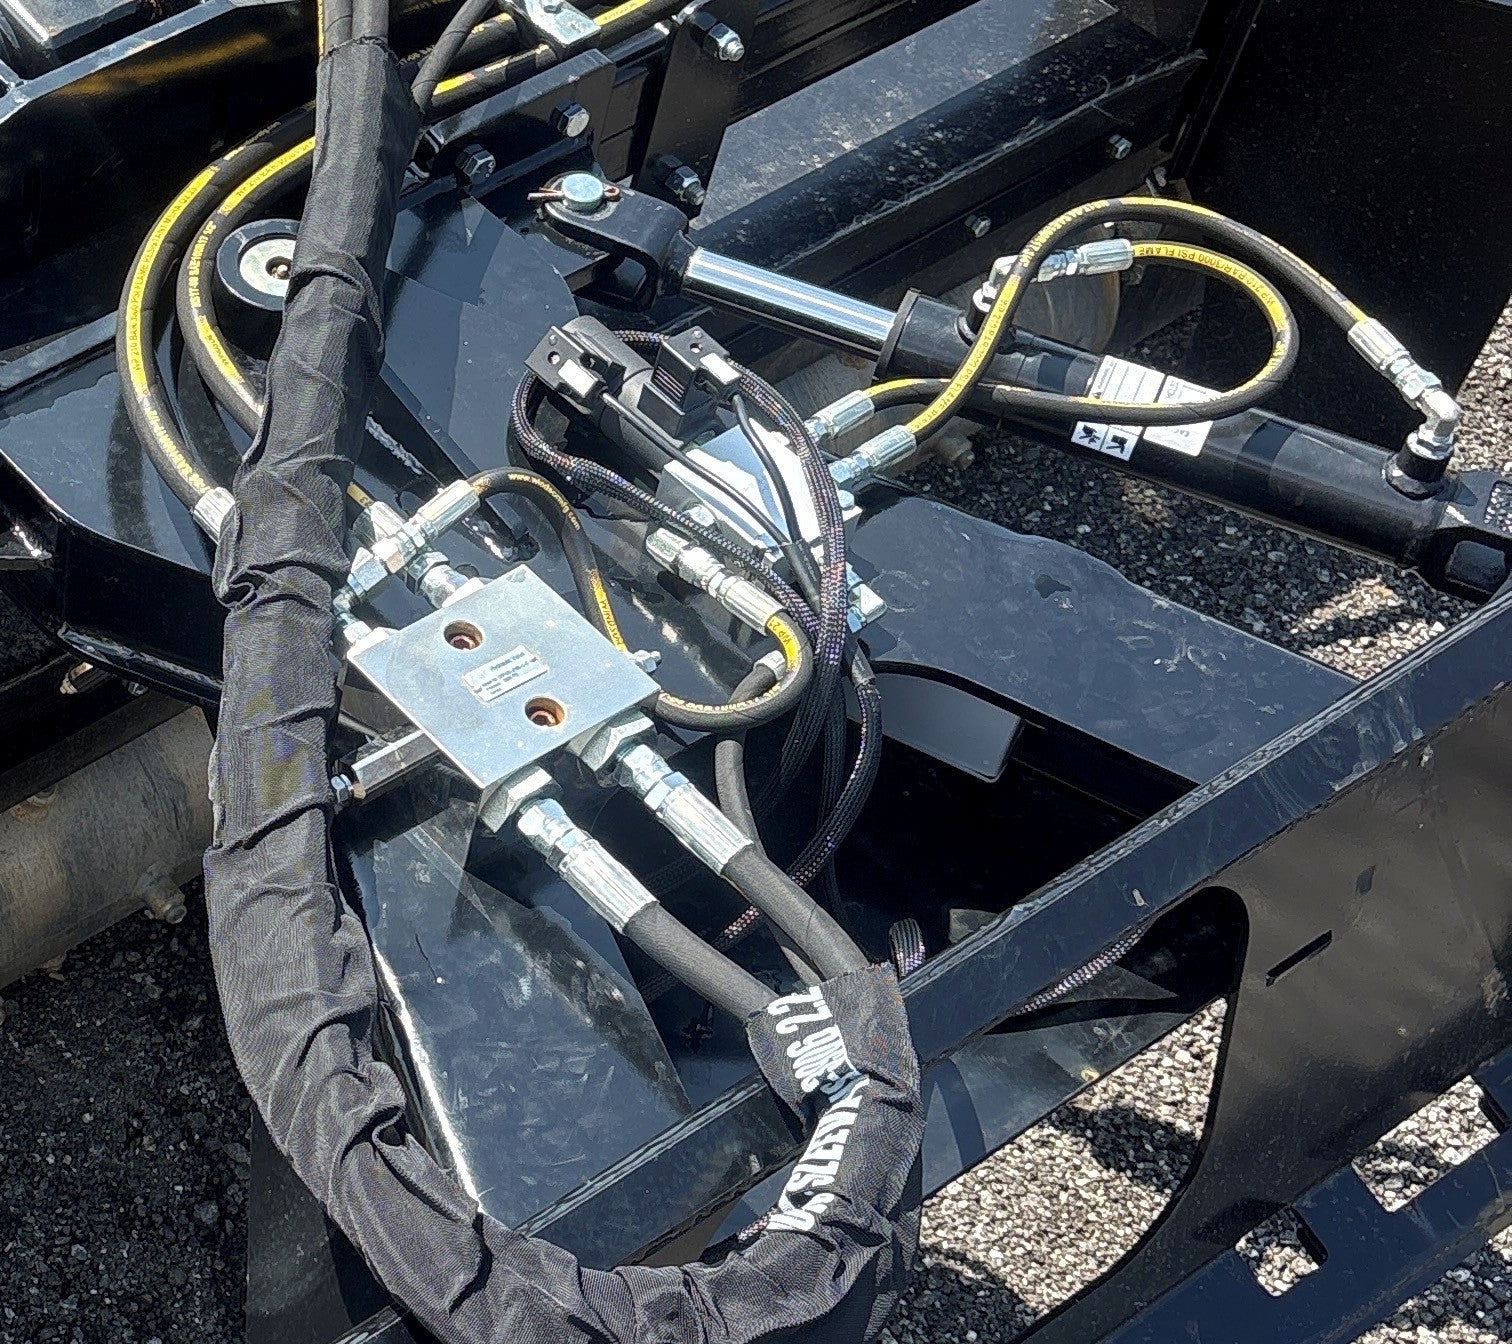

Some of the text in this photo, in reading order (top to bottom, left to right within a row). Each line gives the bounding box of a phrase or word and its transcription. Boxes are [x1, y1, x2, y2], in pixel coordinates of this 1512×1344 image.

[1138, 245, 1175, 257] FLAME
[1178, 248, 1196, 262] PSI
[1197, 253, 1248, 281] BAR/3000
[1246, 276, 1265, 294] 210
